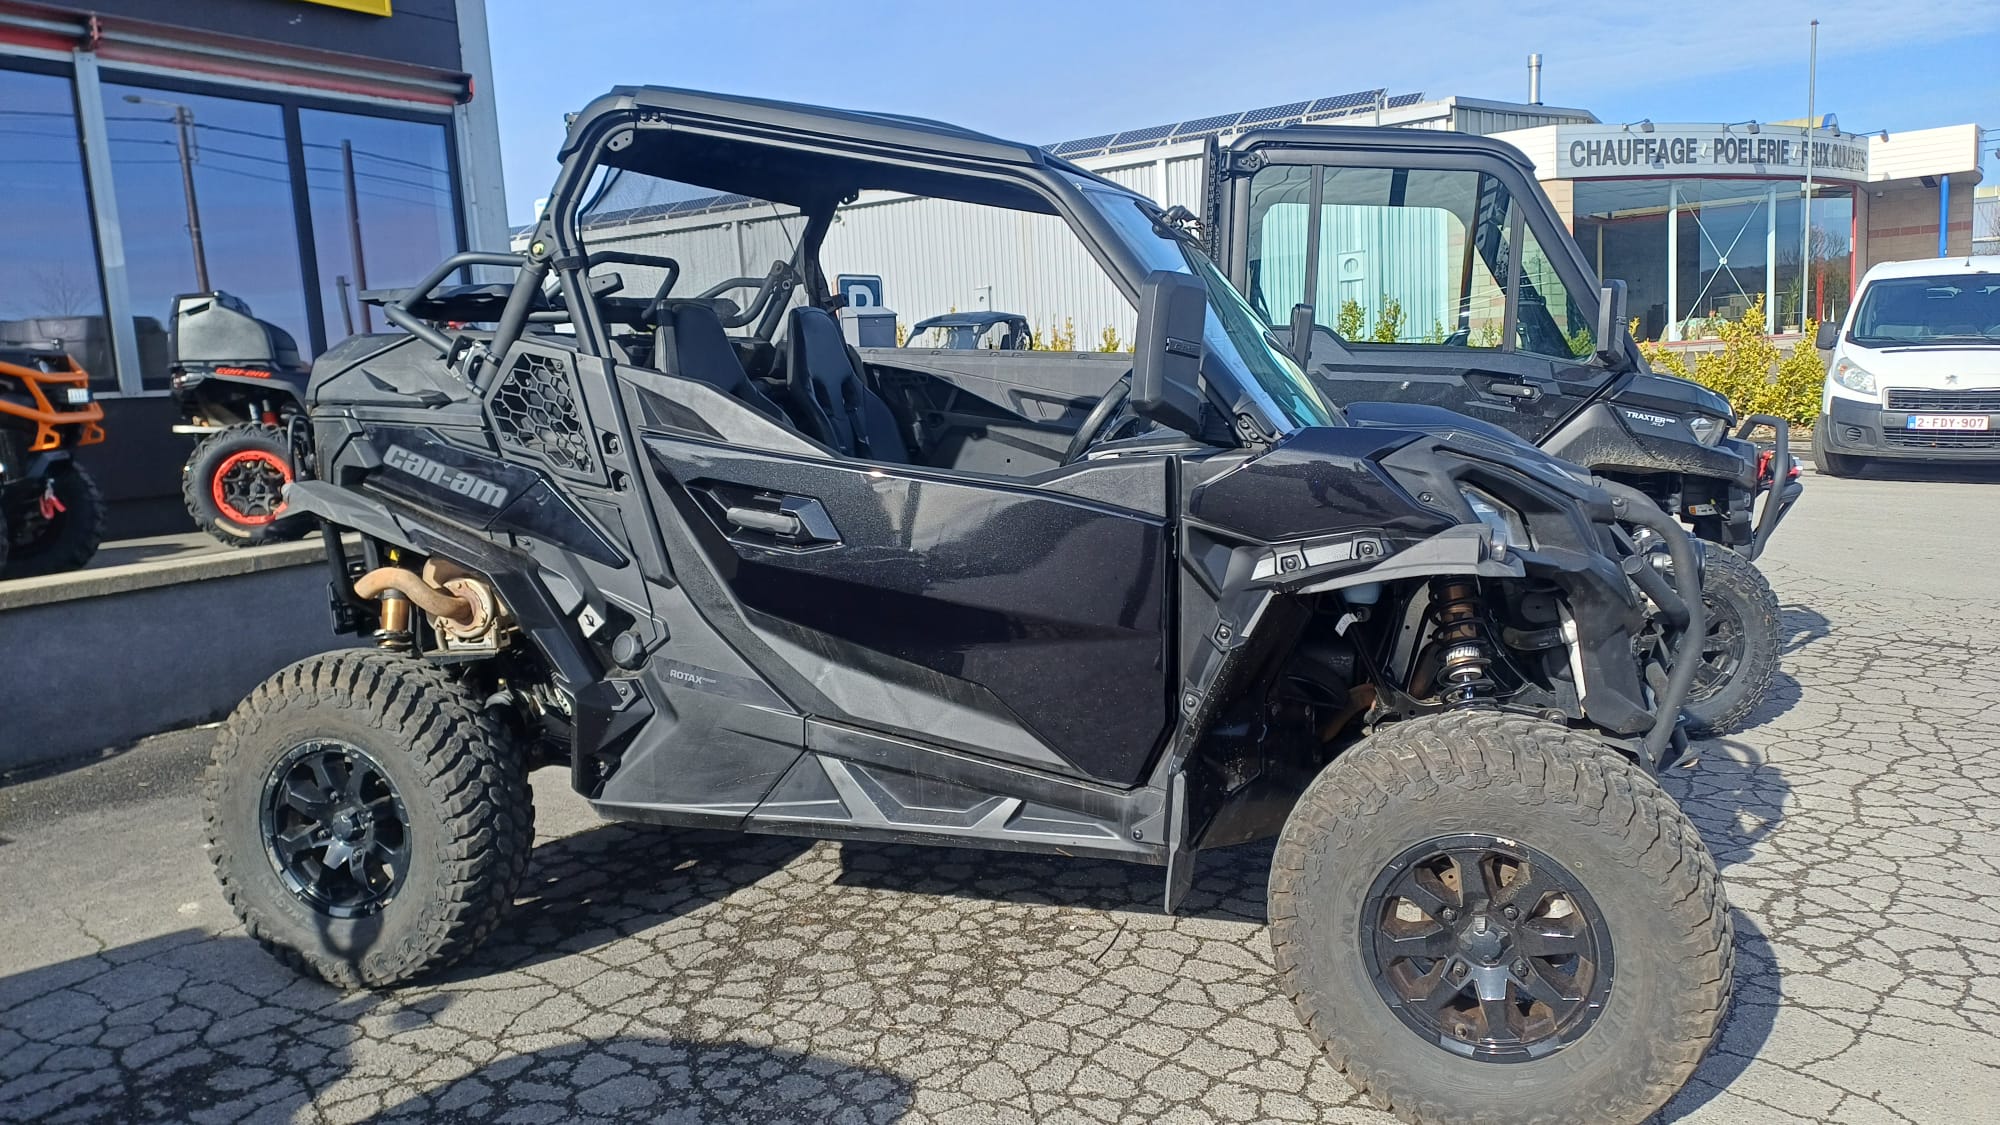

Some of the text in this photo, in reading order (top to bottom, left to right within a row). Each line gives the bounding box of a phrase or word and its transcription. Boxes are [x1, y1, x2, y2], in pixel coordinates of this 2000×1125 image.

[1570, 138, 1698, 167] CHAUFFAGE
[1714, 138, 1789, 164] POELERIE
[1625, 411, 1665, 424] TRAXTER
[383, 444, 508, 508] can-am
[670, 669, 702, 684] ROTAX
